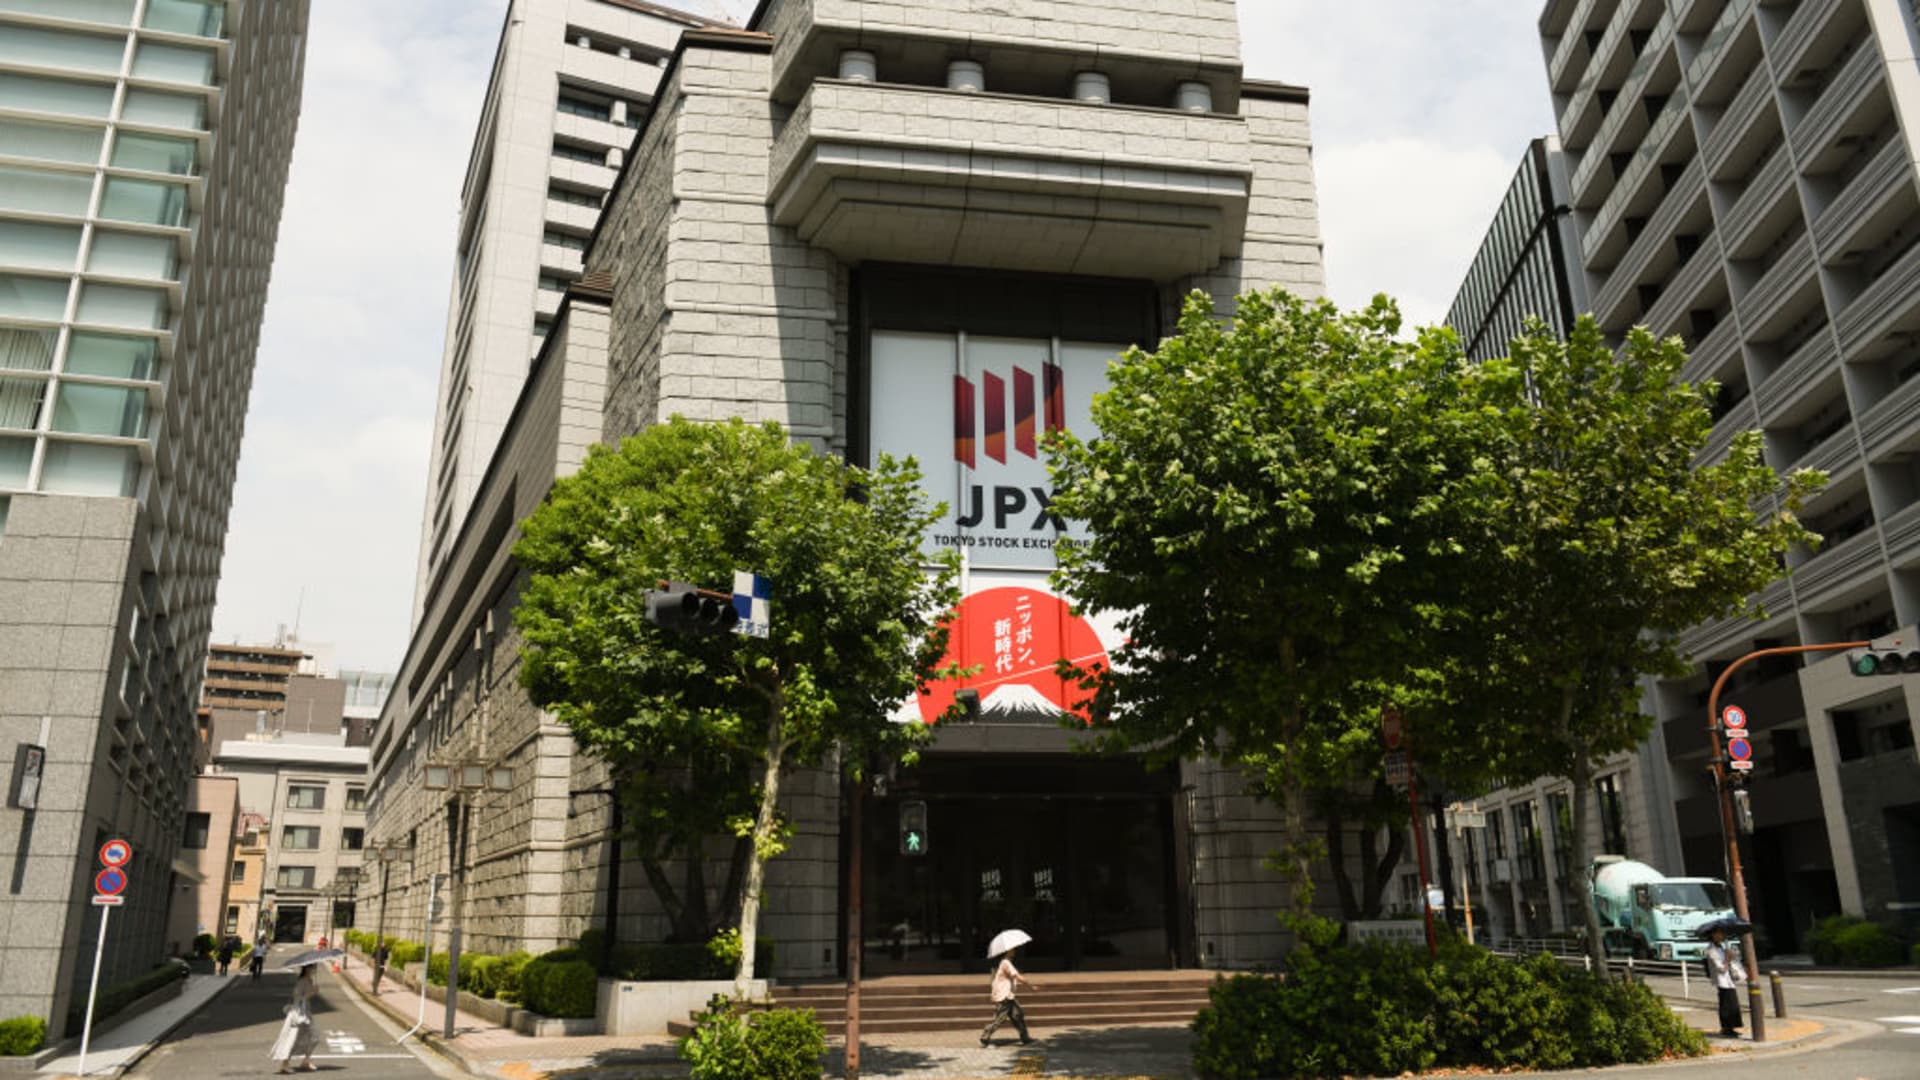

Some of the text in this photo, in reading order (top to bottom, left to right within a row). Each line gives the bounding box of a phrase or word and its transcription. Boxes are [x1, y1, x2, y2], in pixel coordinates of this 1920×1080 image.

[956, 485, 1067, 531] JPX
[934, 535, 976, 547] TOKYO
[978, 536, 1019, 549] STOCK
[994, 617, 1012, 674] 新時代
[1015, 595, 1036, 666] ニッポン、
